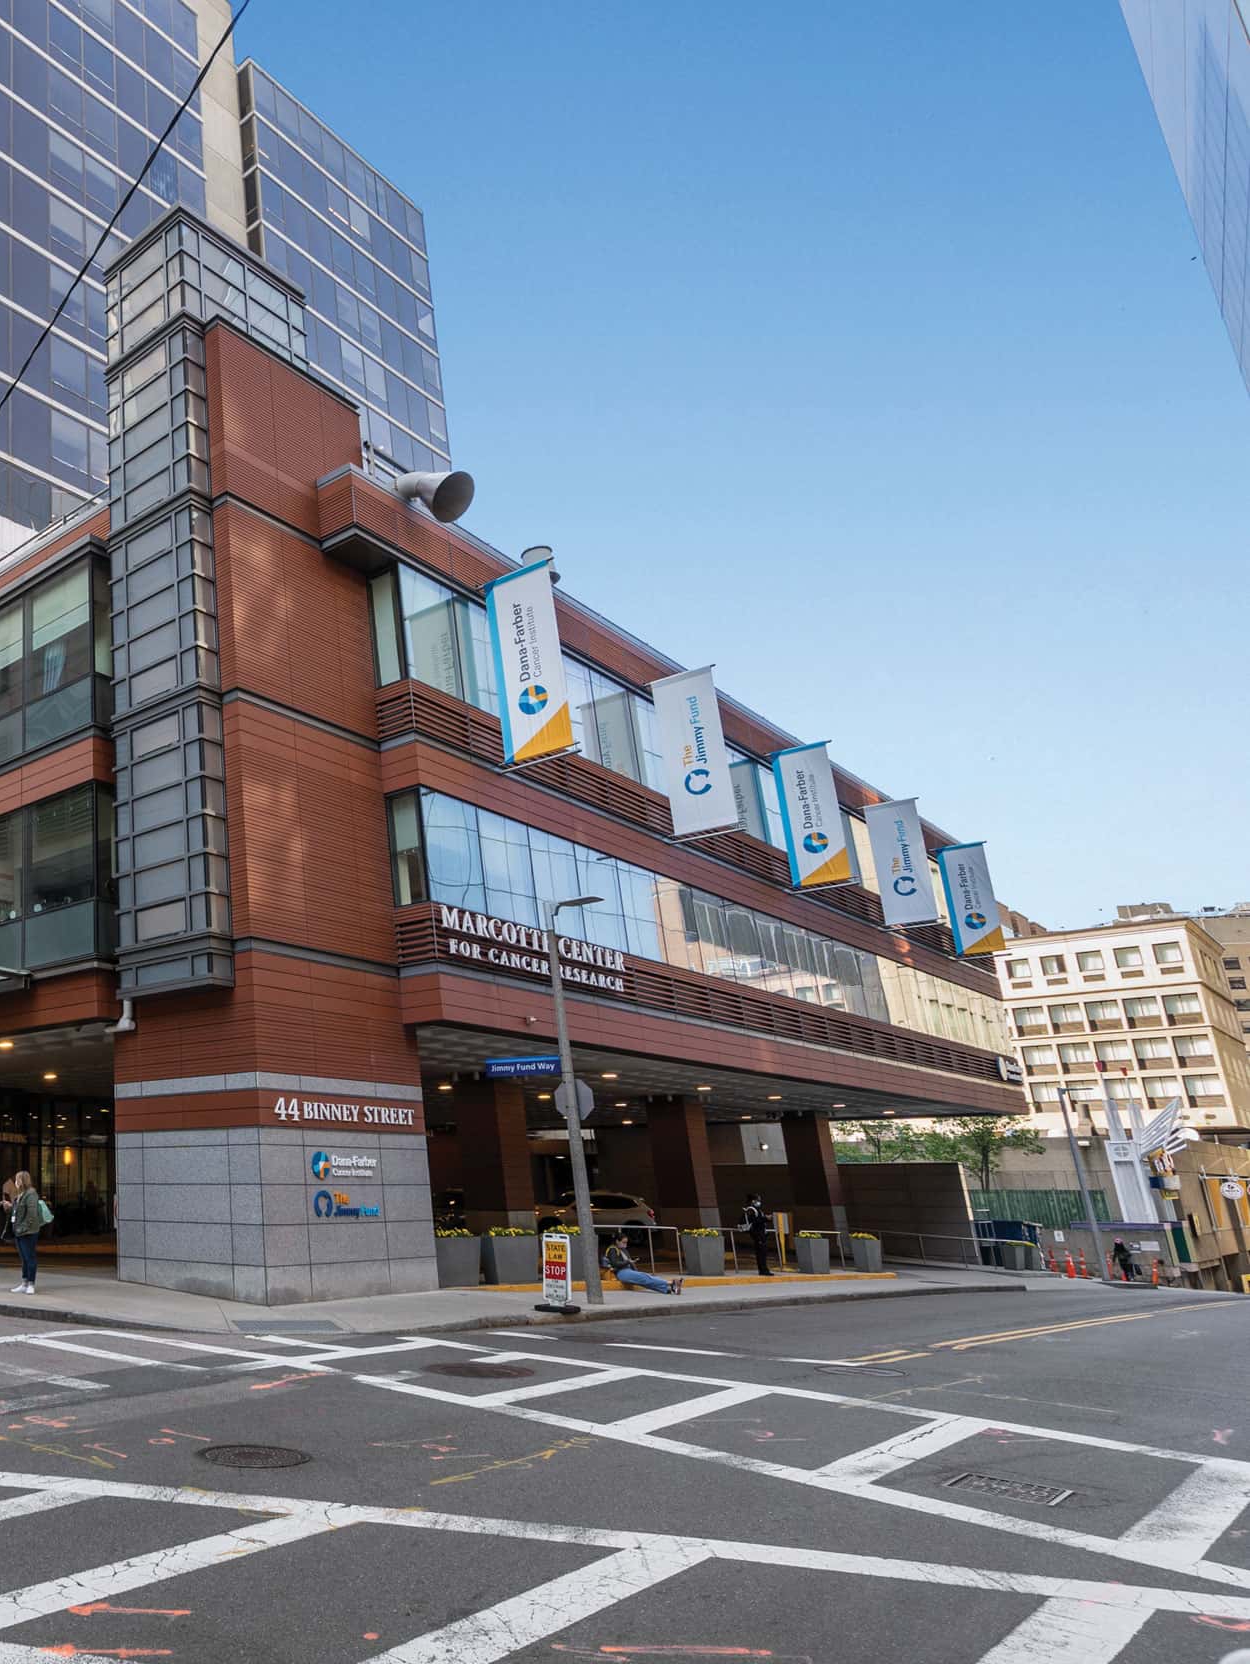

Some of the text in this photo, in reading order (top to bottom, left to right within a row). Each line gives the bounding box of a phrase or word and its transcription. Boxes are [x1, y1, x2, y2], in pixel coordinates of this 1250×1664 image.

[512, 602, 531, 682] Dana-Farber
[526, 606, 542, 677] Cancer Institute
[686, 696, 708, 764] Jimmy Fund
[683, 744, 693, 768] The
[796, 770, 814, 830] Dana-Farber
[894, 820, 913, 873] Jimmy Fund
[892, 857, 901, 876] The
[958, 863, 973, 911] Dana-Farber
[448, 938, 482, 960] FOR
[488, 948, 551, 976] CANCER
[558, 937, 626, 972] CENTER
[491, 1062, 556, 1073] Jimmy Fund Way
[274, 1096, 415, 1126] 44 BINNEY STREET
[331, 1154, 377, 1168] Dana-Farber
[333, 1191, 350, 1205] The
[333, 1203, 381, 1219] Jimmy Fund
[544, 1242, 566, 1253] STATE
[548, 1252, 564, 1260] LAW
[545, 1265, 566, 1275] STOP
